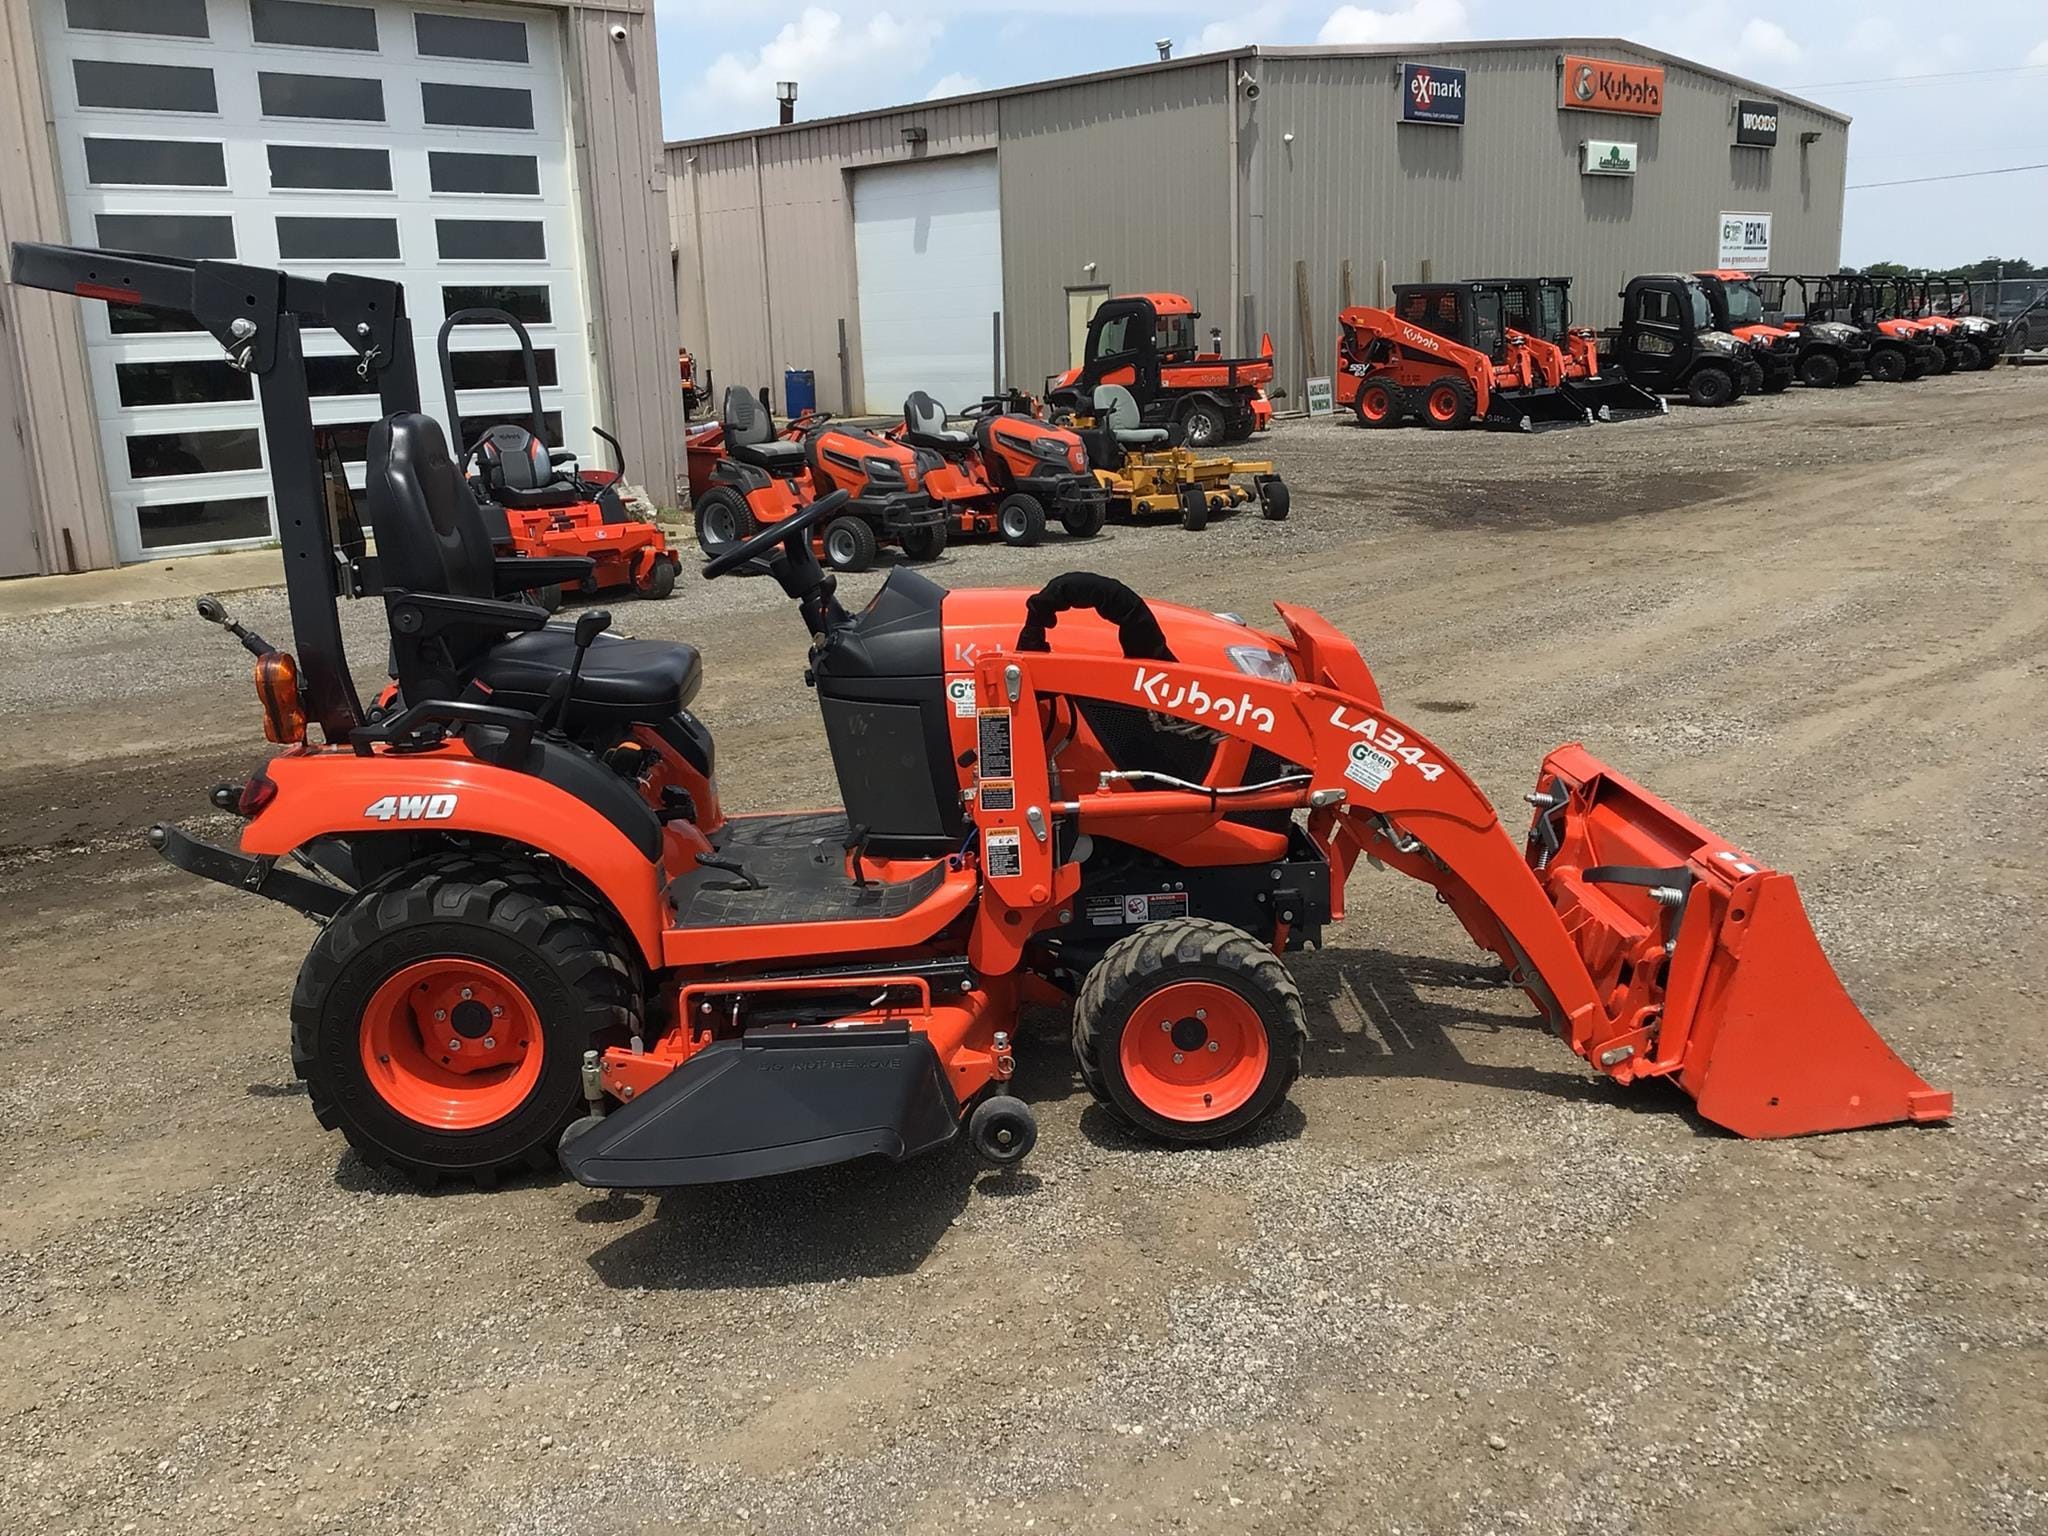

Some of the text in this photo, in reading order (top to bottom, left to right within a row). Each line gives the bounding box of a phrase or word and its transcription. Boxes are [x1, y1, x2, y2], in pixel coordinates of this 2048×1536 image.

[1599, 71, 1659, 105] Kubota
[1742, 112, 1776, 132] WOODS
[1744, 222, 1767, 245] RENTAL
[1403, 326, 1440, 351] Kubota
[1348, 363, 1370, 372] SSV
[1133, 666, 1275, 733] Kubota
[1329, 705, 1445, 782] LA344
[1352, 743, 1392, 768] Green
[364, 794, 458, 820] 4WD
[830, 1058, 902, 1070] REMOVE
